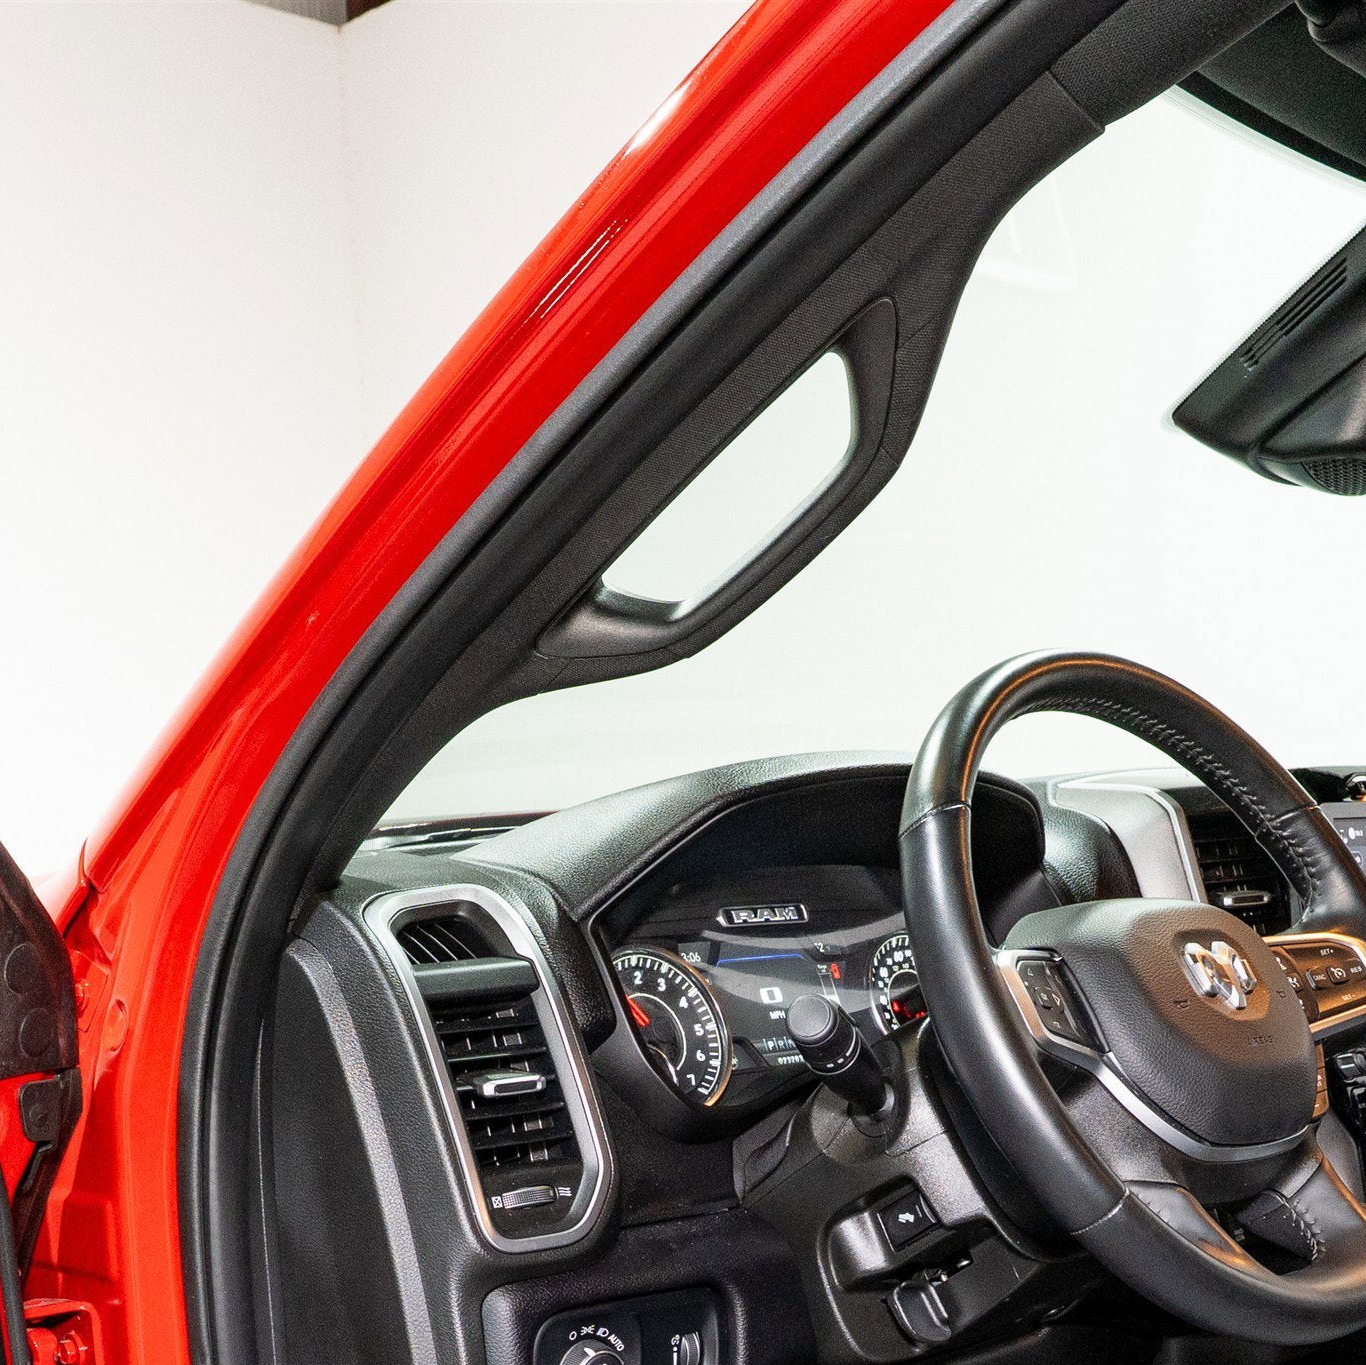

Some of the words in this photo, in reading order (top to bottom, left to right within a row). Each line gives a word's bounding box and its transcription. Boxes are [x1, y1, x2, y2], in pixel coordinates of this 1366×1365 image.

[732, 907, 798, 923] RAM
[635, 971, 642, 985] 2
[657, 977, 666, 992] 3
[679, 996, 688, 1009] 4
[694, 1023, 705, 1036] 5
[695, 1049, 706, 1061] 6
[686, 1074, 696, 1086] 7
[607, 1333, 625, 1352] AUTO
